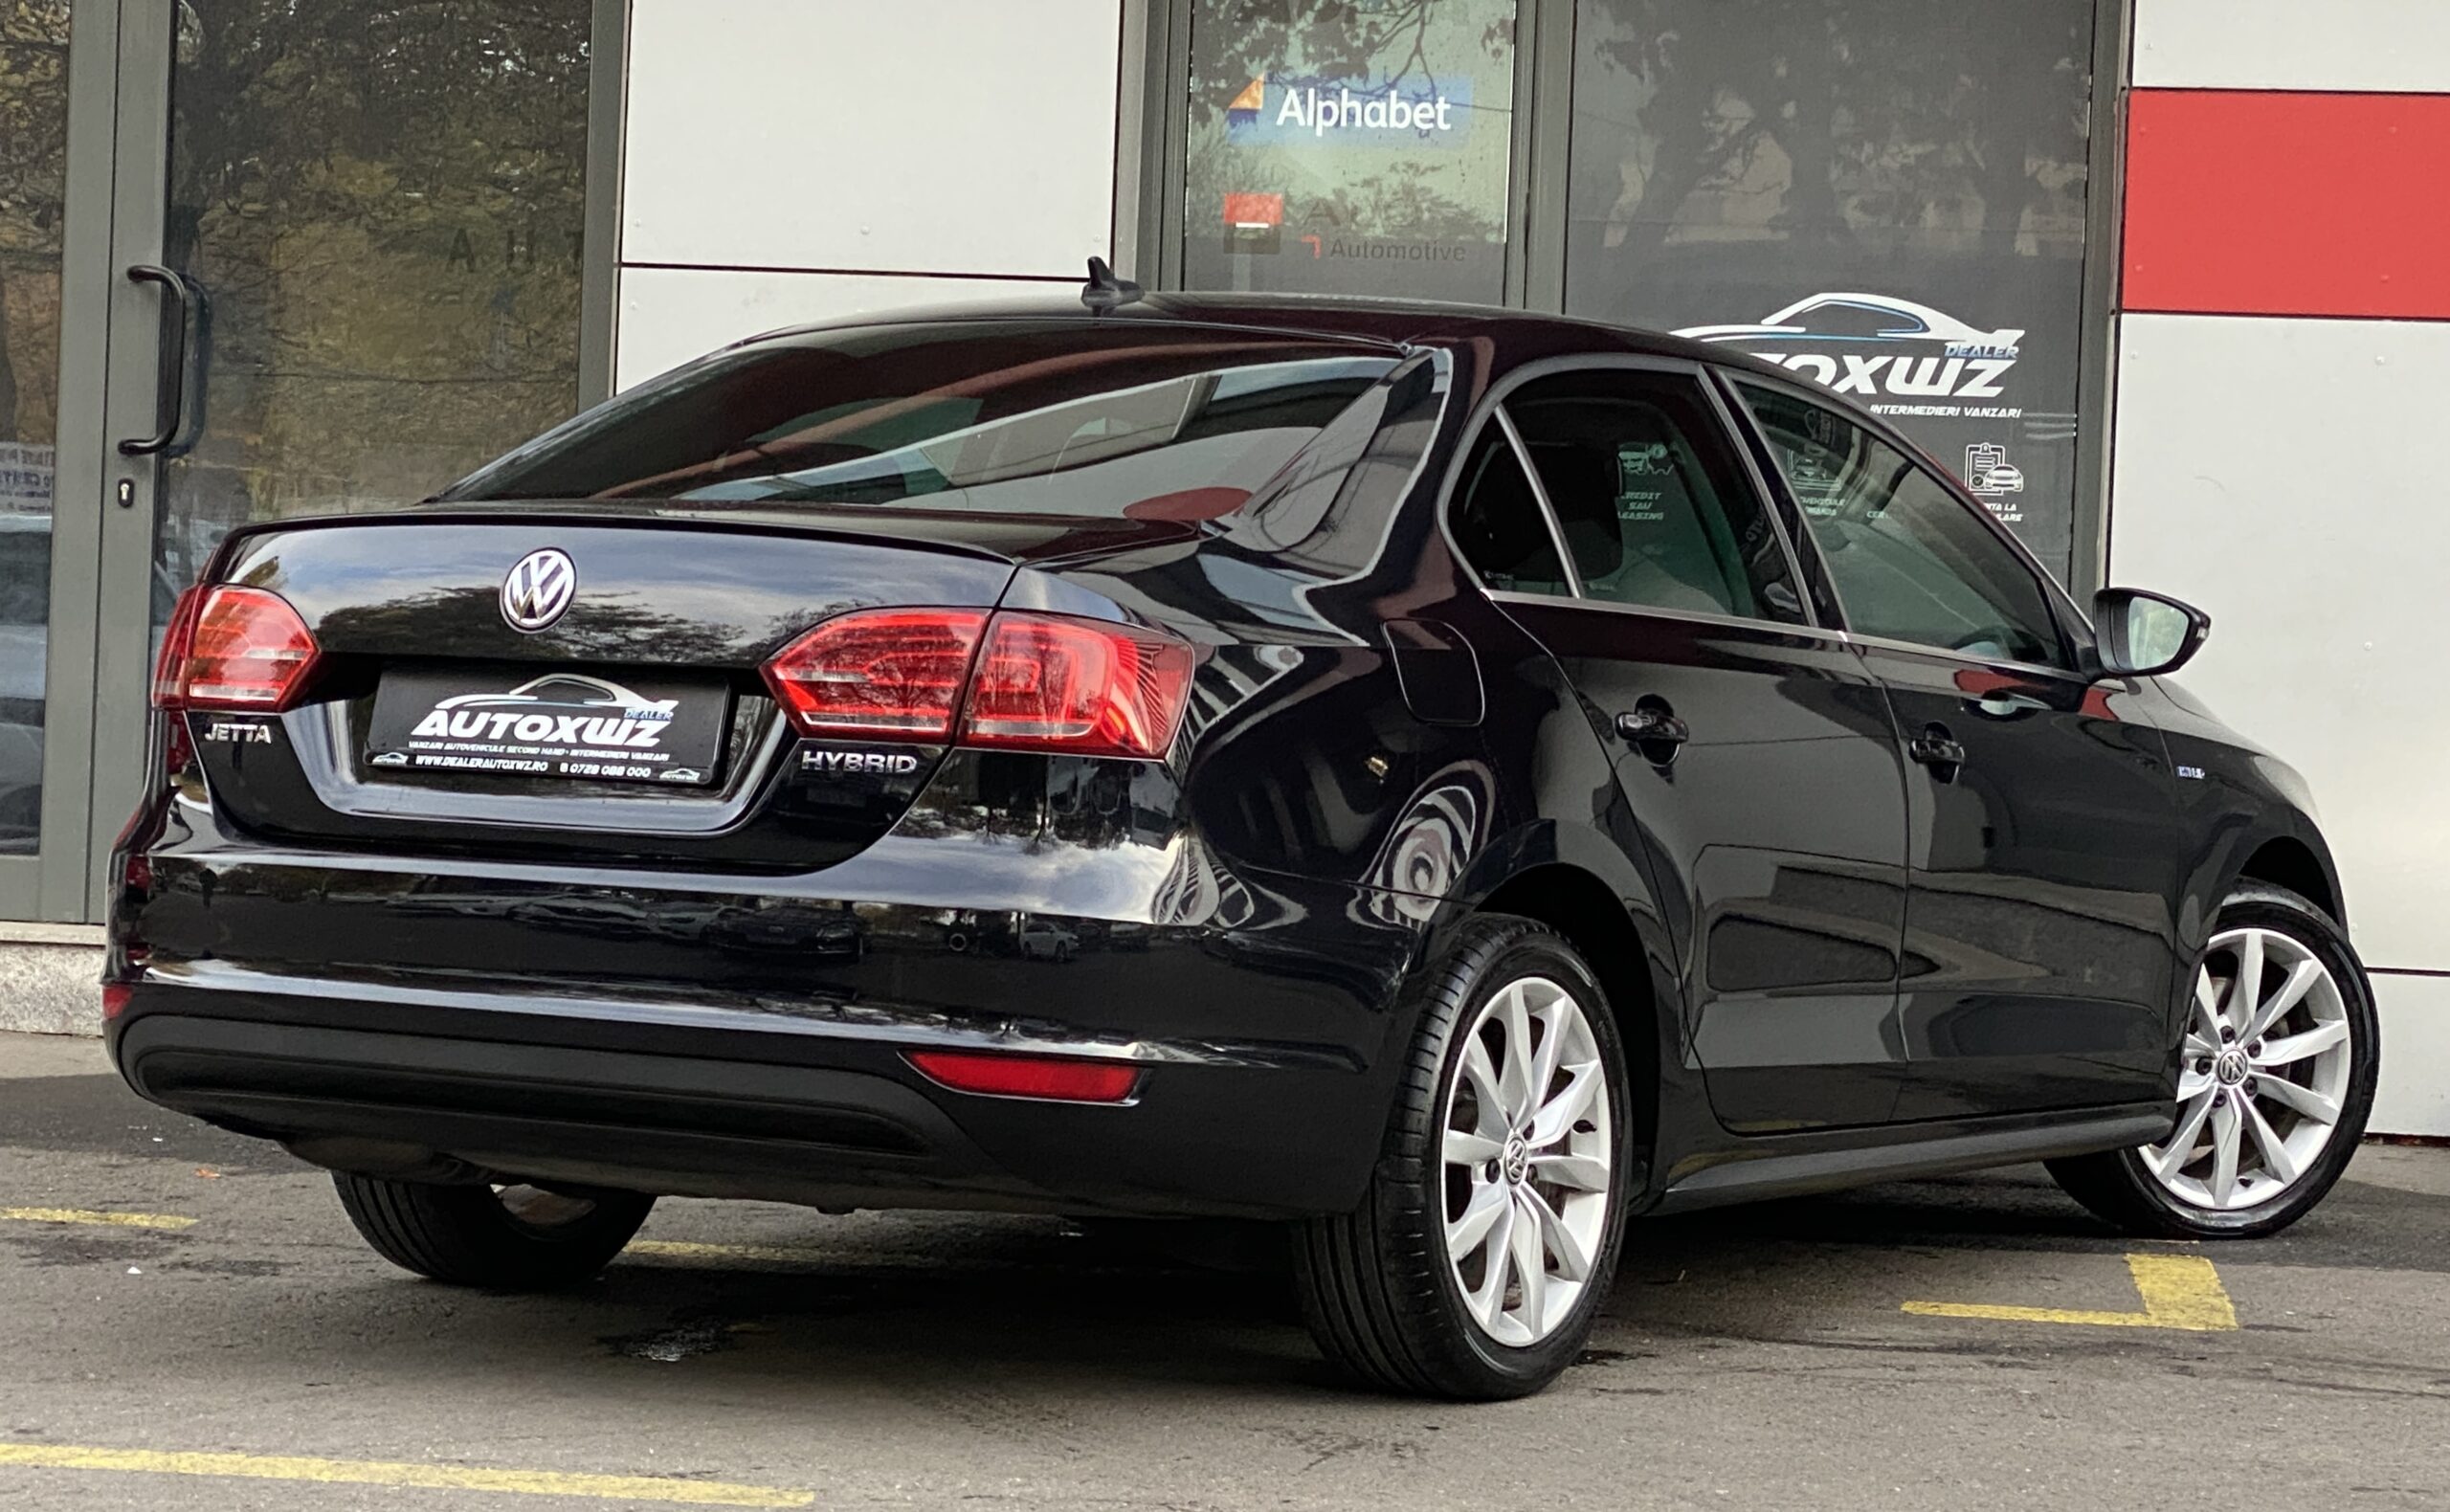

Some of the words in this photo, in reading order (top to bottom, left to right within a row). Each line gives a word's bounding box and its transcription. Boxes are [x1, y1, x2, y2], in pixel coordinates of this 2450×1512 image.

[1276, 87, 1452, 137] Alphabet
[1330, 239, 1467, 262] Automotive
[1944, 341, 2020, 359] DEALER
[1869, 405, 1960, 417] INTERMEDIERI
[1962, 407, 2022, 418] VANZARI
[1628, 501, 1653, 510] SAU
[2004, 502, 2017, 511] LA
[623, 708, 675, 720] DEALER
[204, 723, 272, 745] JETTA
[411, 709, 672, 747] AUTOXWZ
[408, 741, 444, 750] VANZARI
[444, 742, 504, 754] AUTOVEHICULE
[506, 745, 541, 755] SECOND
[542, 747, 567, 756] HAND
[631, 752, 671, 762] VANZARI
[801, 750, 918, 773] HYBRID
[415, 755, 549, 772] WWW.DEALERAUTOXWZ.RO
[627, 767, 652, 778] 000
